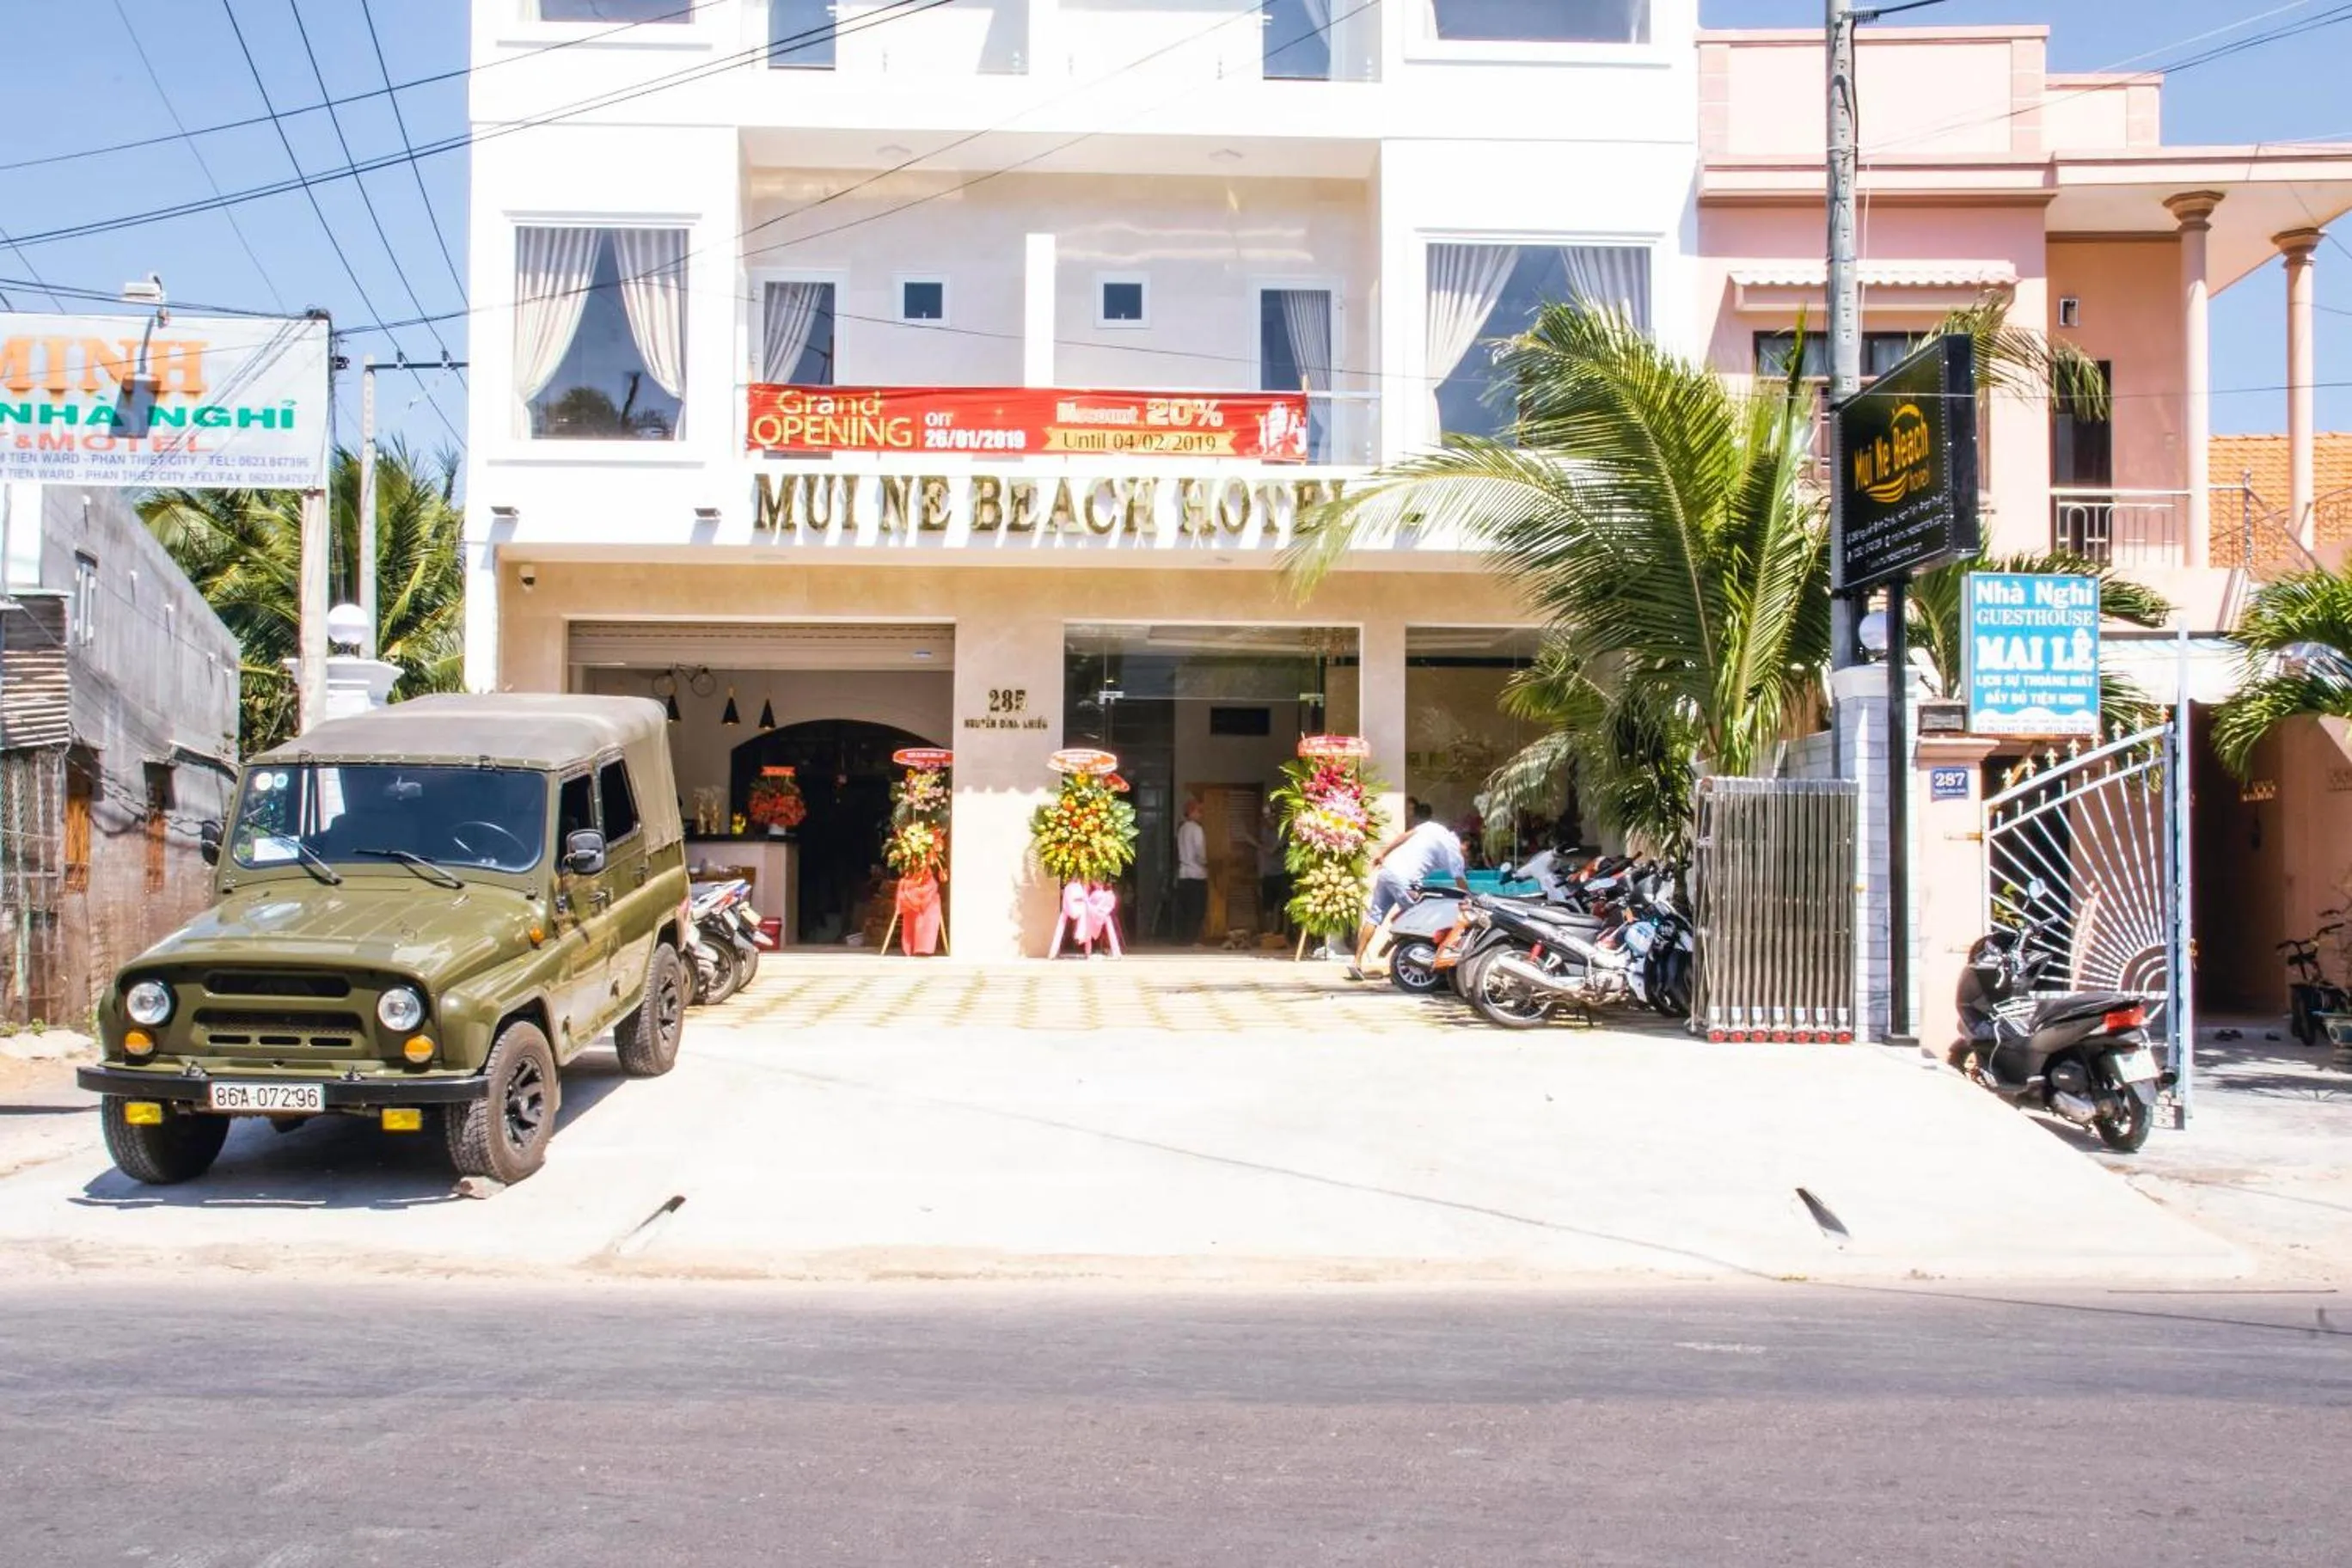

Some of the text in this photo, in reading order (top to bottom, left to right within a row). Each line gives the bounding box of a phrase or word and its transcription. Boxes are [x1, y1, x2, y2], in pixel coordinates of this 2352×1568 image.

[776, 390, 882, 416] Grand
[1146, 398, 1223, 426] 20%
[752, 414, 912, 448] OPENING
[1063, 432, 1216, 452] Until 04/02/2019
[42, 452, 80, 464] WARD
[91, 454, 126, 465] PHAN
[1875, 434, 1890, 481] Ne
[1893, 415, 1930, 472] Beach
[754, 474, 859, 530] MUI
[879, 475, 952, 531] NE
[970, 475, 1159, 535] BEACH
[1975, 580, 2024, 605] Nhà
[1977, 609, 2095, 626] GUESTHOUSE
[1975, 628, 2095, 671] MAI LÊ
[1934, 772, 1966, 787] 287
